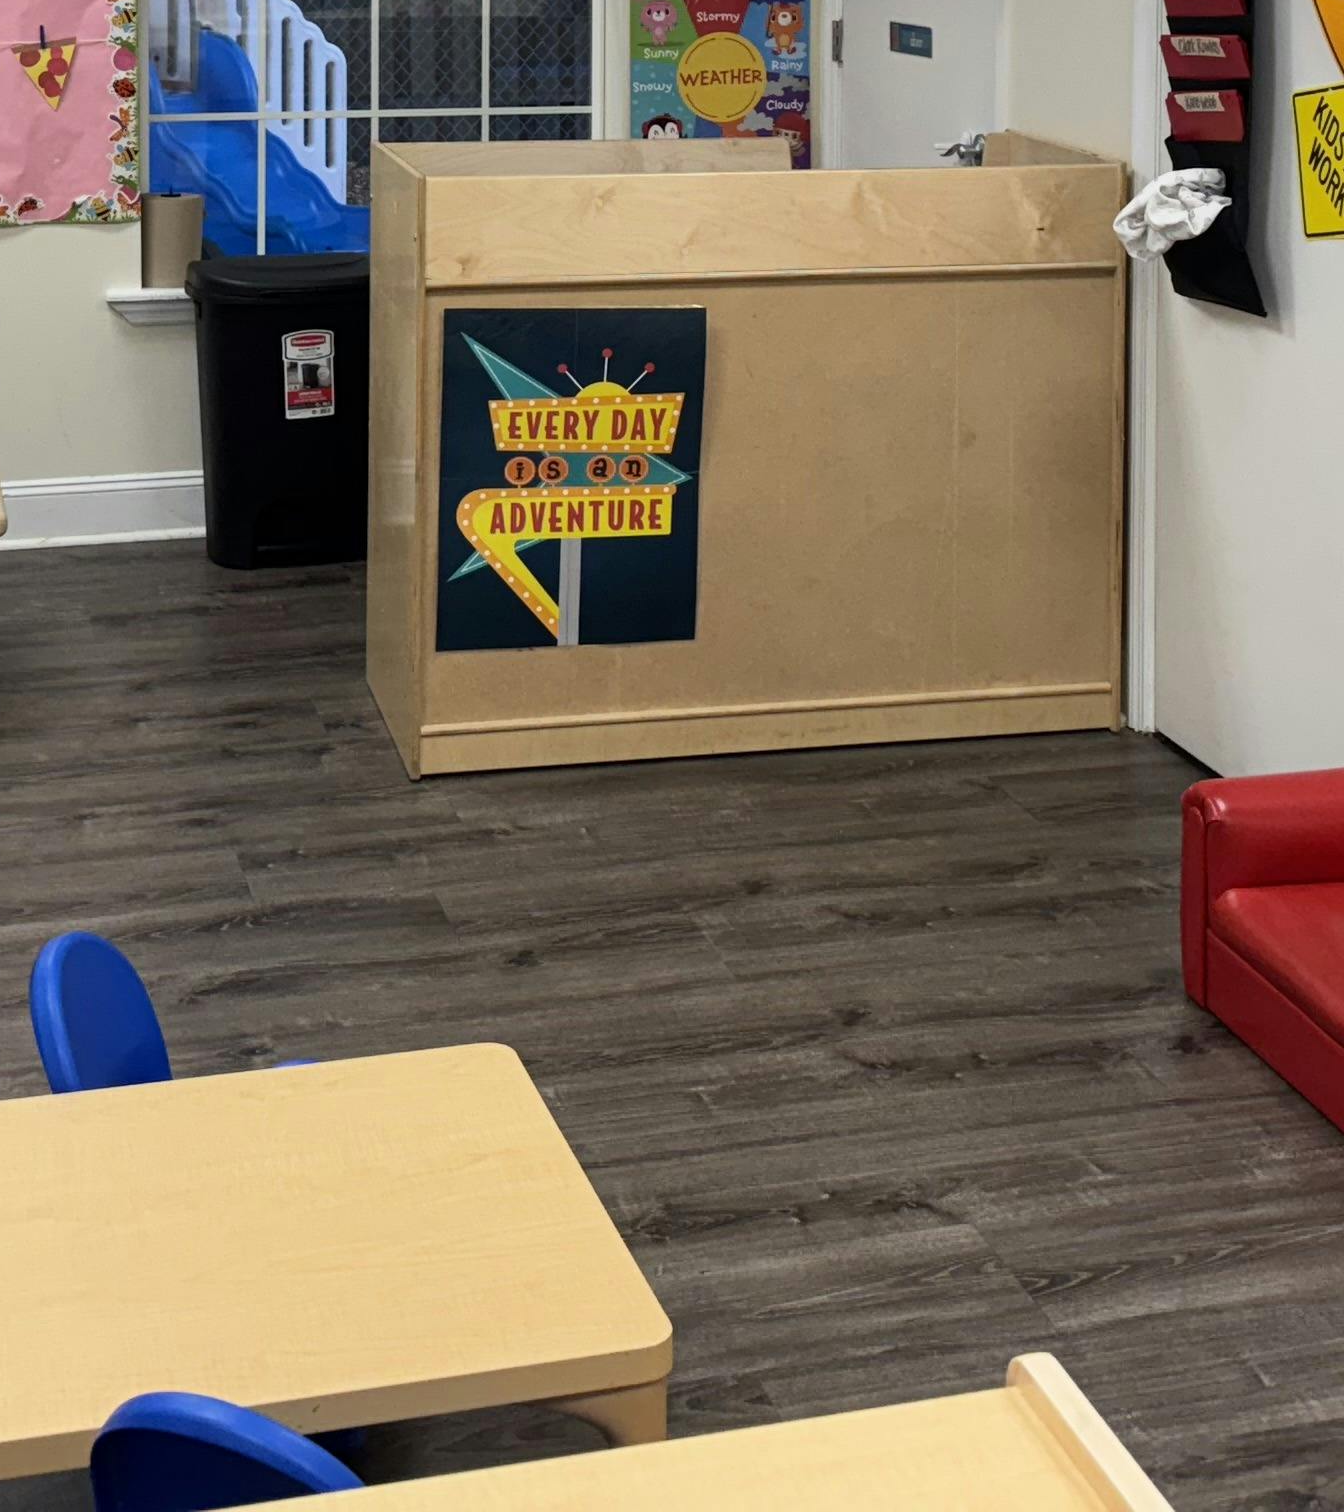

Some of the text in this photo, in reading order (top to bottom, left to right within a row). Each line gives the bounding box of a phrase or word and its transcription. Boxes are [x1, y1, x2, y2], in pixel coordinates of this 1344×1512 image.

[696, 10, 741, 24] Stormy
[643, 48, 679, 60] Sunny
[771, 60, 804, 73] Rainy
[680, 68, 763, 87] WEATHER
[632, 81, 673, 93] Snowy
[765, 99, 804, 112] Cloudy
[507, 407, 668, 441] EVERY DAY
[515, 458, 642, 481] is an
[489, 498, 664, 535] ADVENTURE
